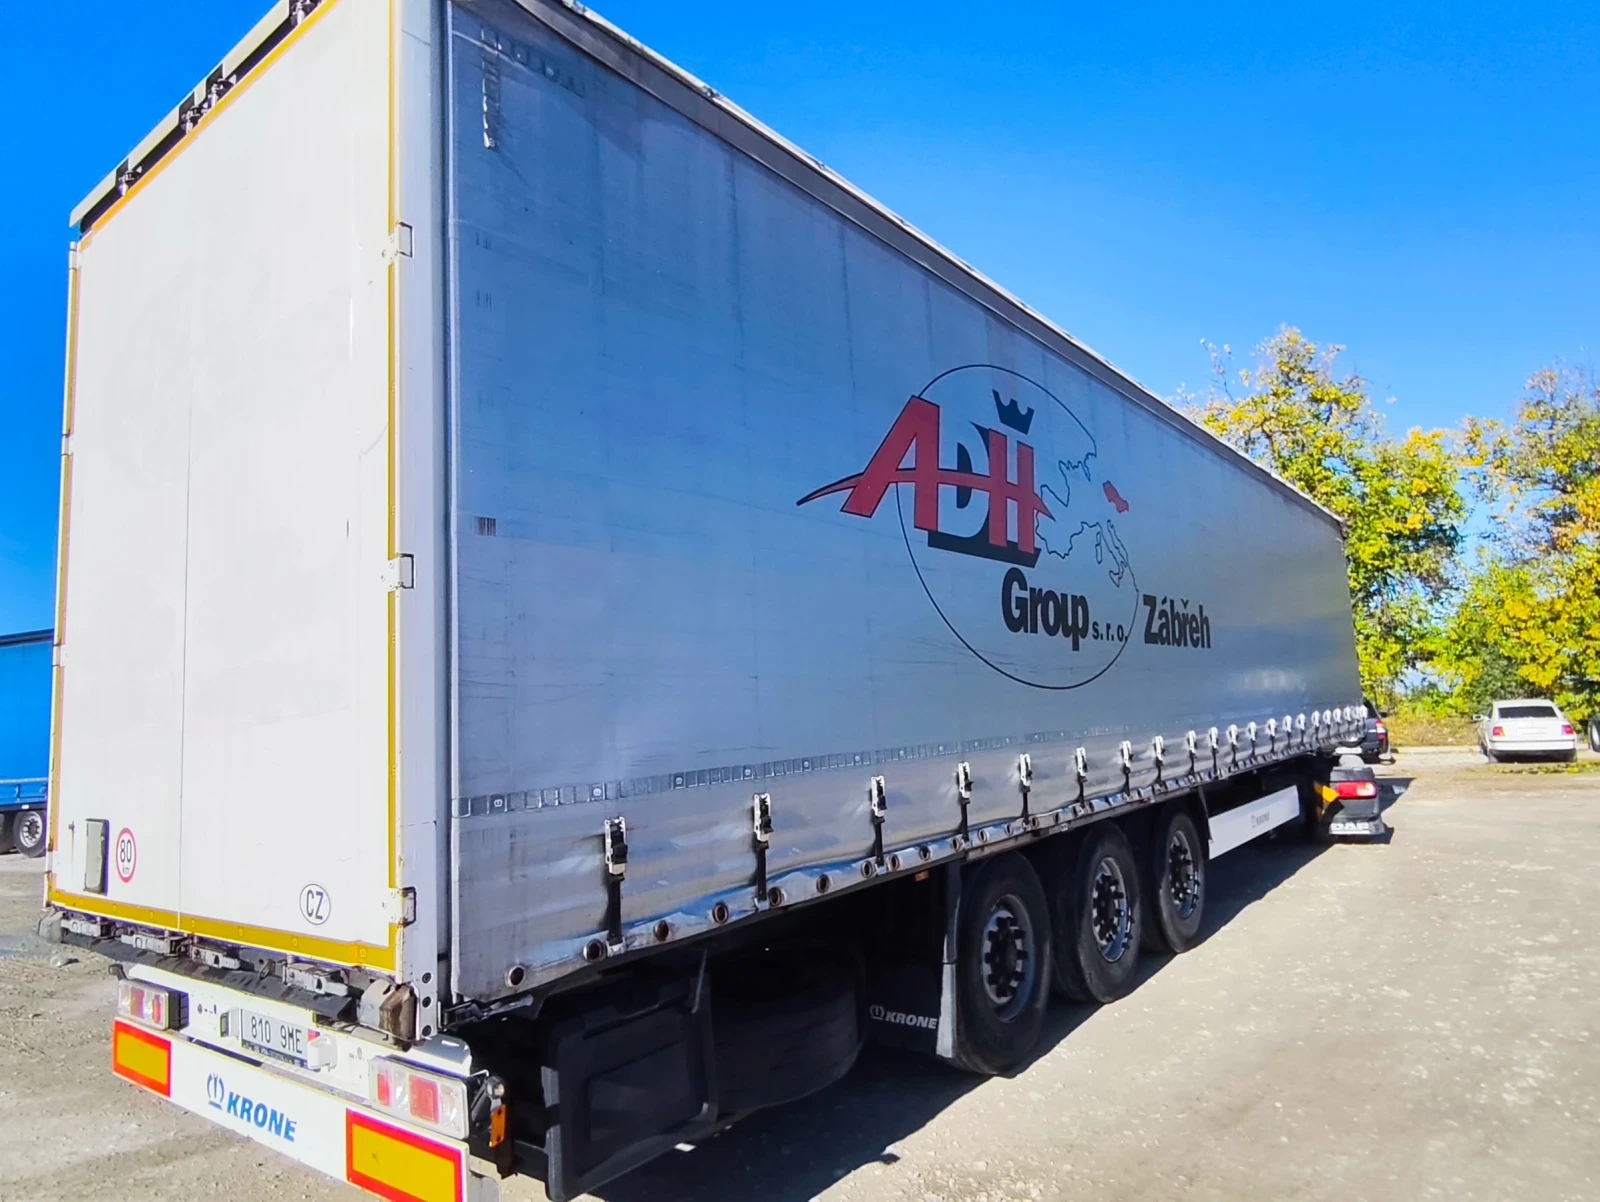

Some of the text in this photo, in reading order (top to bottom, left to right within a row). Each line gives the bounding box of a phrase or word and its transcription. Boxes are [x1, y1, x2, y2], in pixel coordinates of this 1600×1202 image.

[797, 394, 1056, 568] ADH
[1001, 566, 1090, 651] Group
[1143, 594, 1212, 648] Zábřeh
[120, 839, 132, 863] 80
[306, 889, 324, 920] CZ
[251, 1015, 303, 1054] 810 9ME
[885, 1011, 938, 1030] KRONE
[226, 1090, 297, 1143] KRONE
